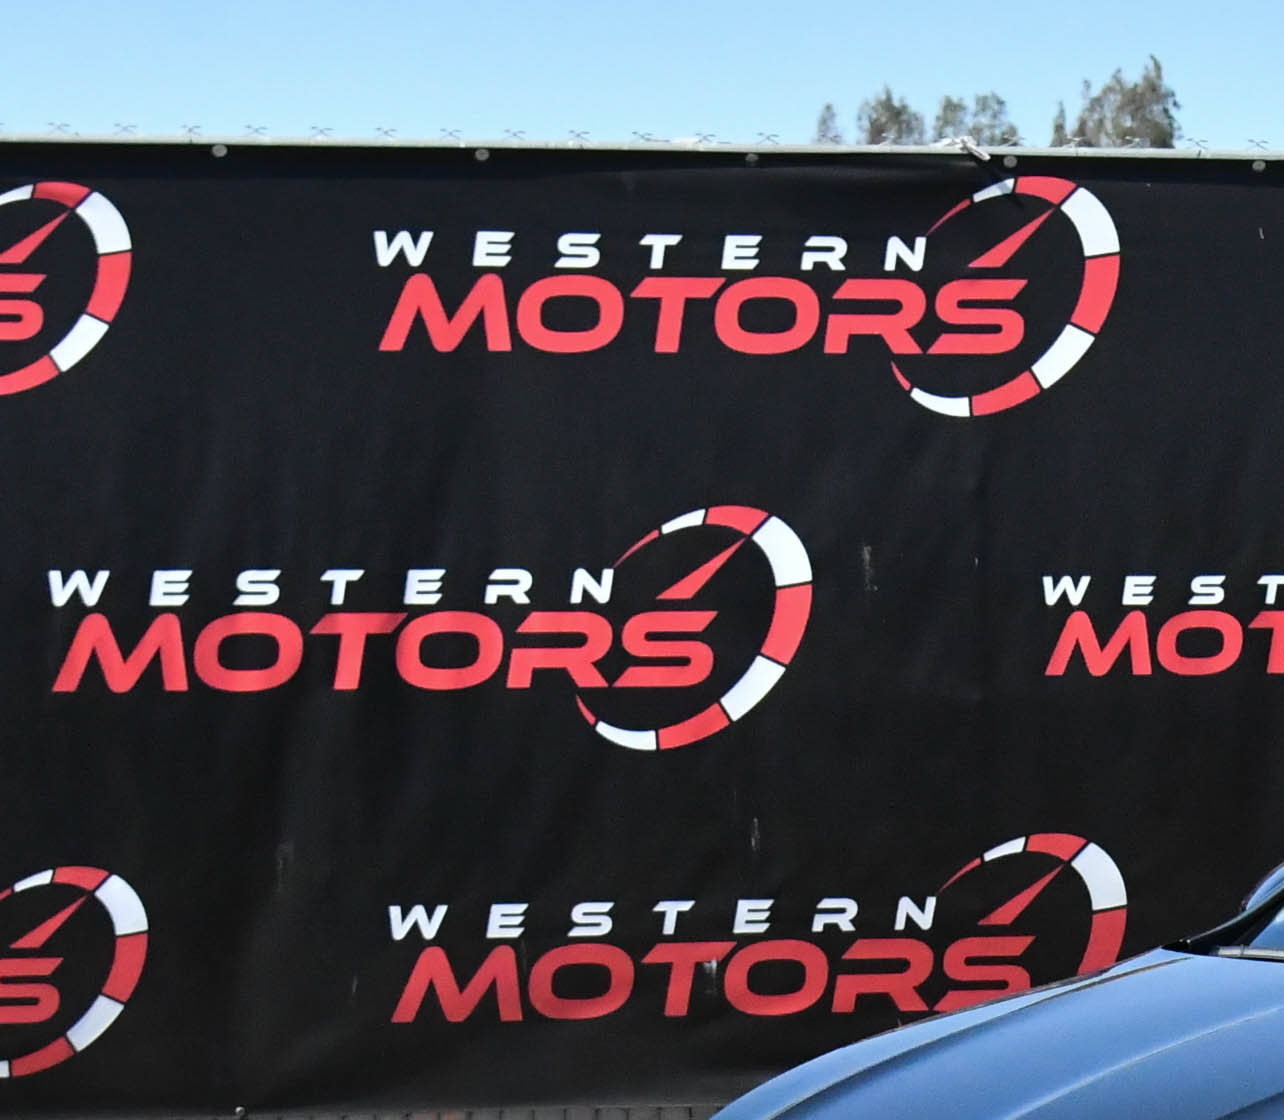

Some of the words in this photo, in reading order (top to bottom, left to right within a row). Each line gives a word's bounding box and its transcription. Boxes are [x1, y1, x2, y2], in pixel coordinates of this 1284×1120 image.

[374, 231, 926, 271] WESTERN
[379, 273, 1026, 354] MOTORS
[49, 568, 614, 607] WESTERN
[53, 611, 716, 693] MOTORS
[389, 897, 936, 940] WESTERN
[392, 936, 1034, 1022] MOTORS
